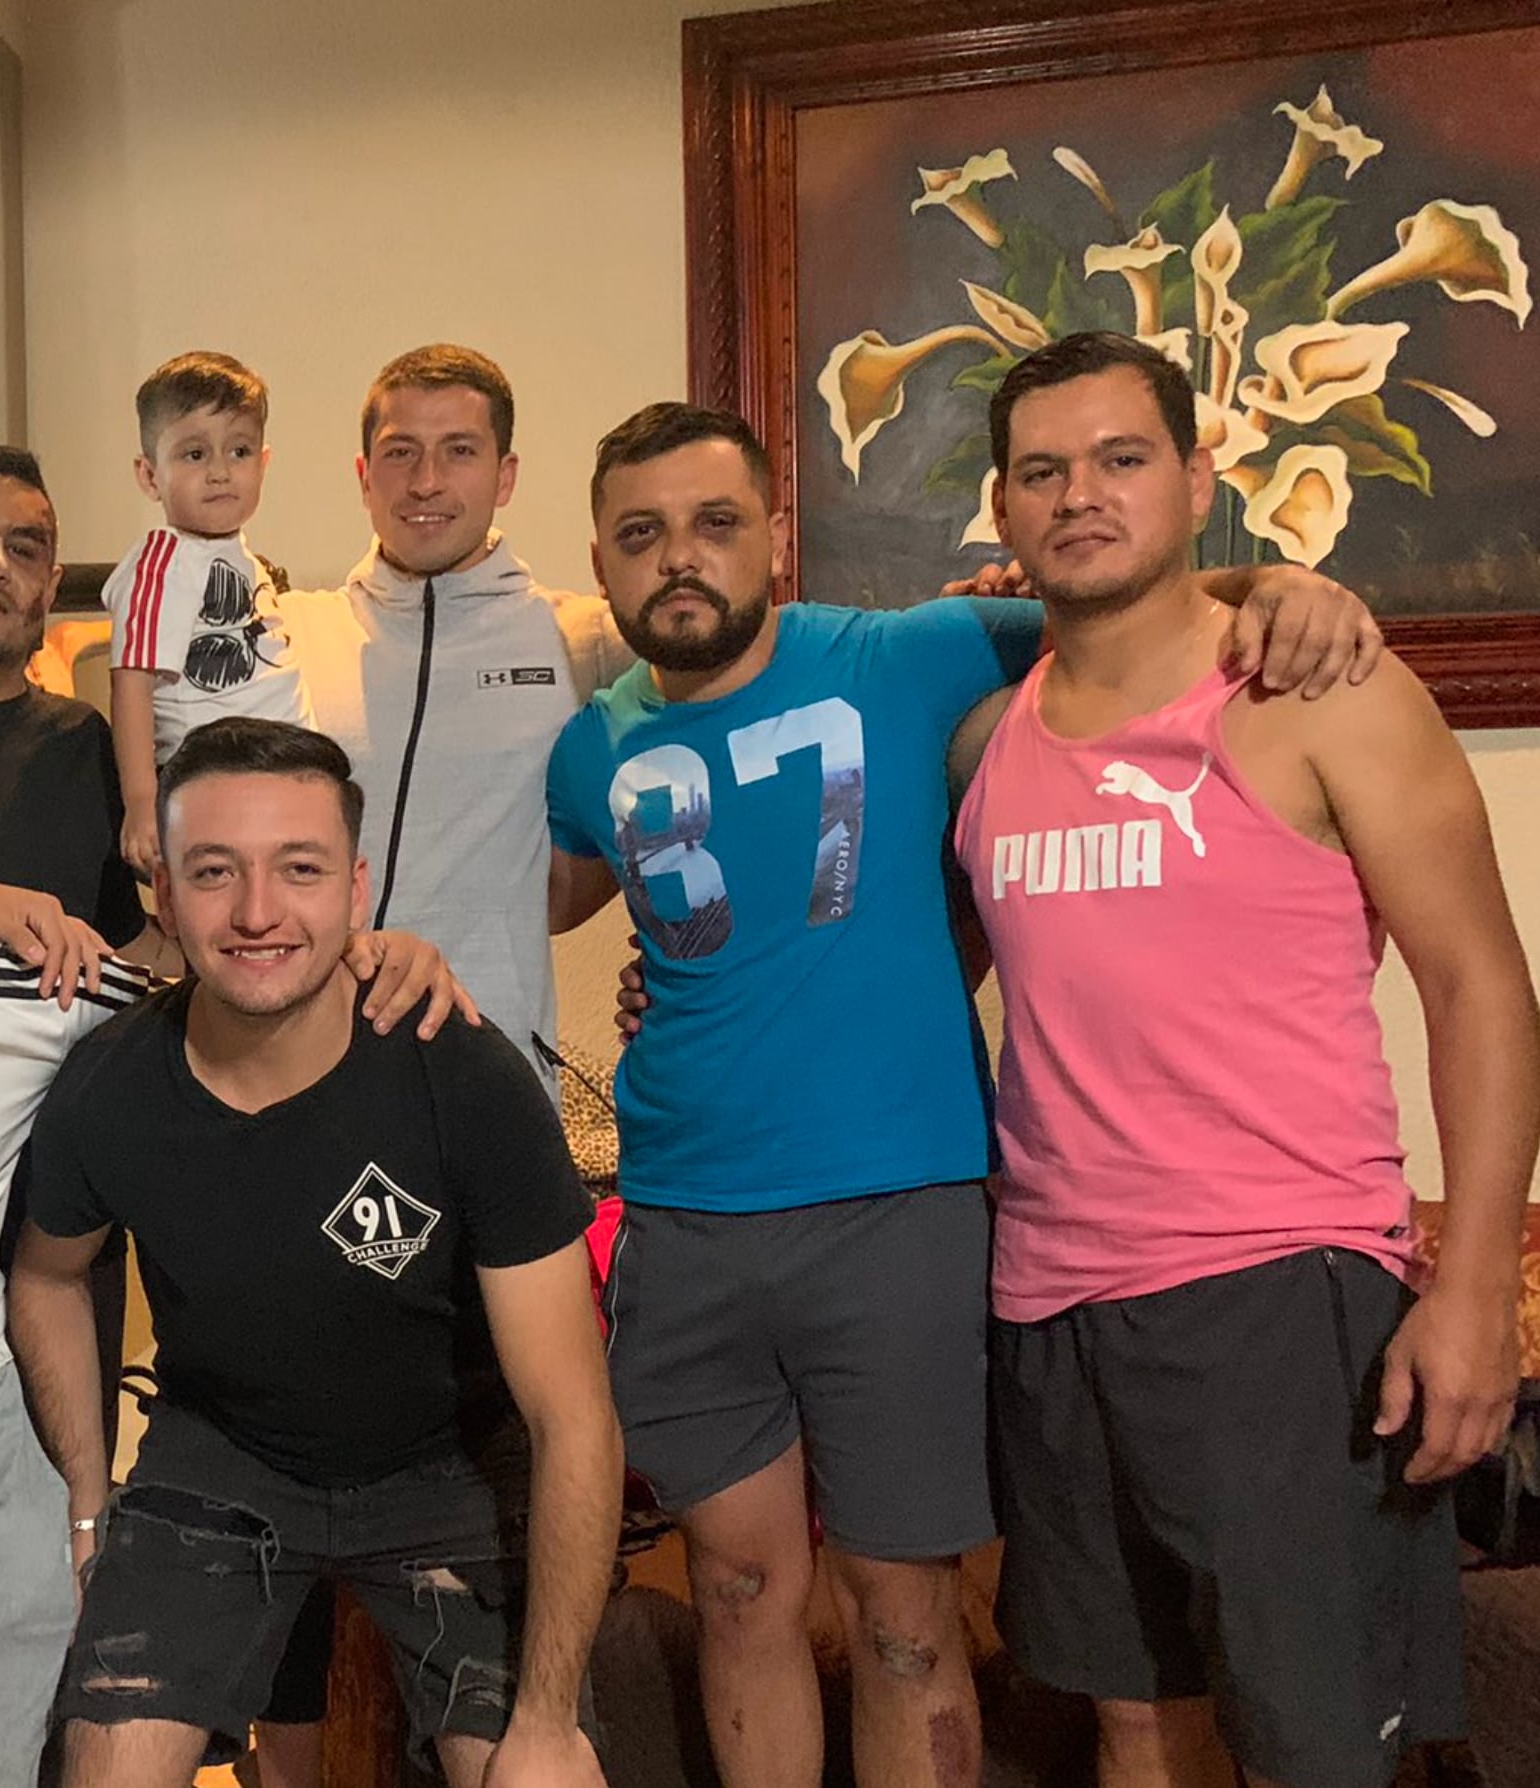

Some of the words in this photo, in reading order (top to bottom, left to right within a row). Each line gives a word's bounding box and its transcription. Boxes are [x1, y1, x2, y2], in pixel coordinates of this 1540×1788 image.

[608, 696, 865, 961] 87
[992, 818, 1162, 901] PUMA
[352, 1194, 403, 1242] 91
[346, 1241, 428, 1264] CHALLENGE
